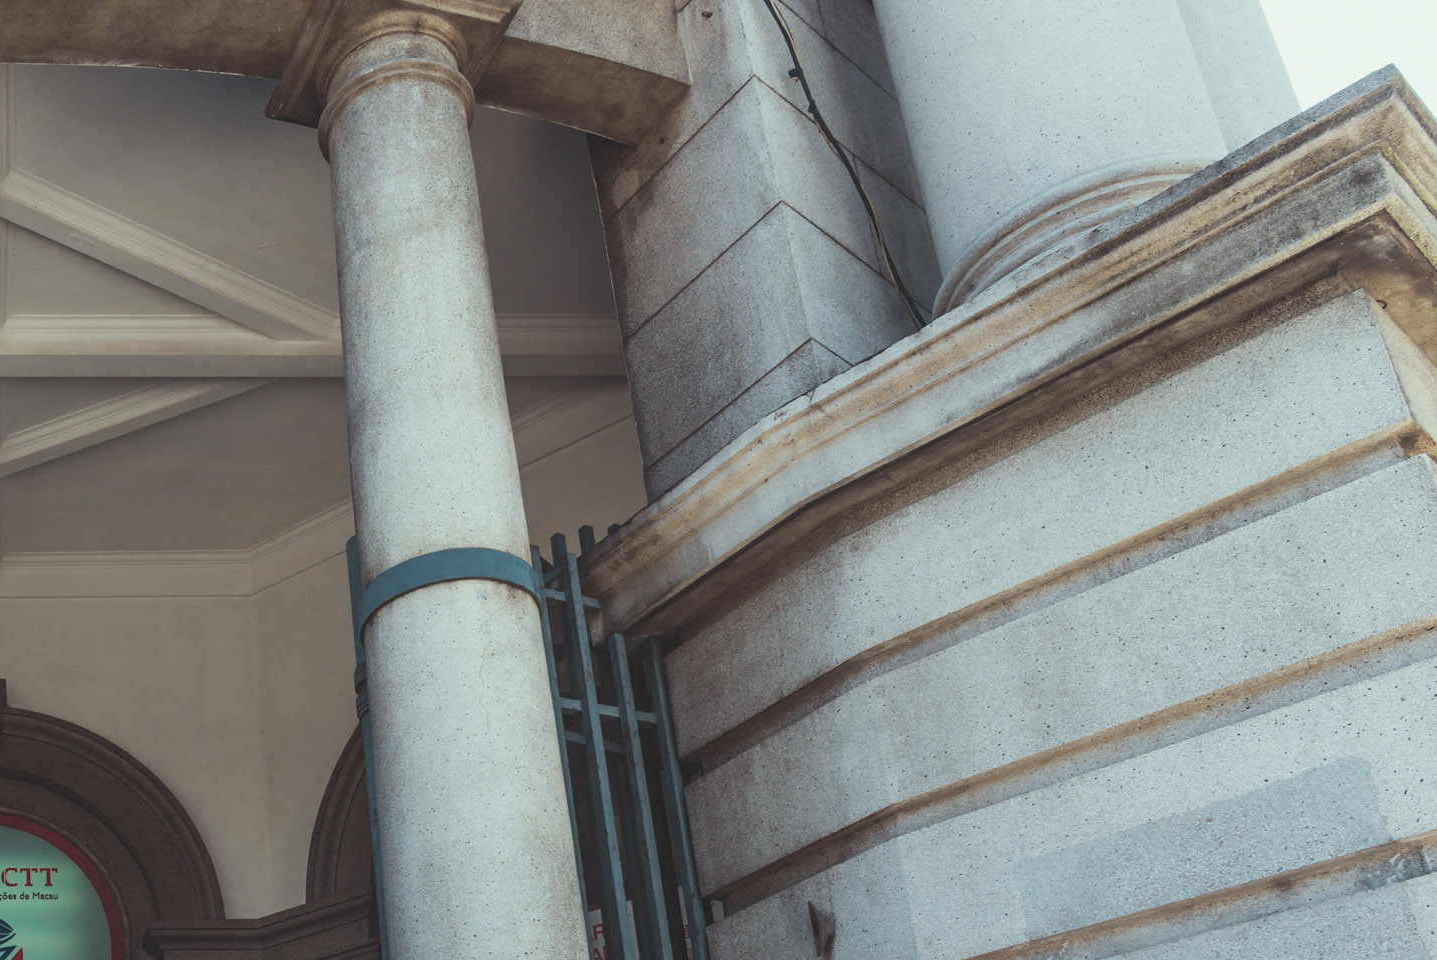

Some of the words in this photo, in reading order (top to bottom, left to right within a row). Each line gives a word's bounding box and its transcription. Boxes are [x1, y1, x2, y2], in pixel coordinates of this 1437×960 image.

[1, 868, 58, 887] CTT
[20, 892, 29, 900] de
[32, 892, 58, 900] Macau
